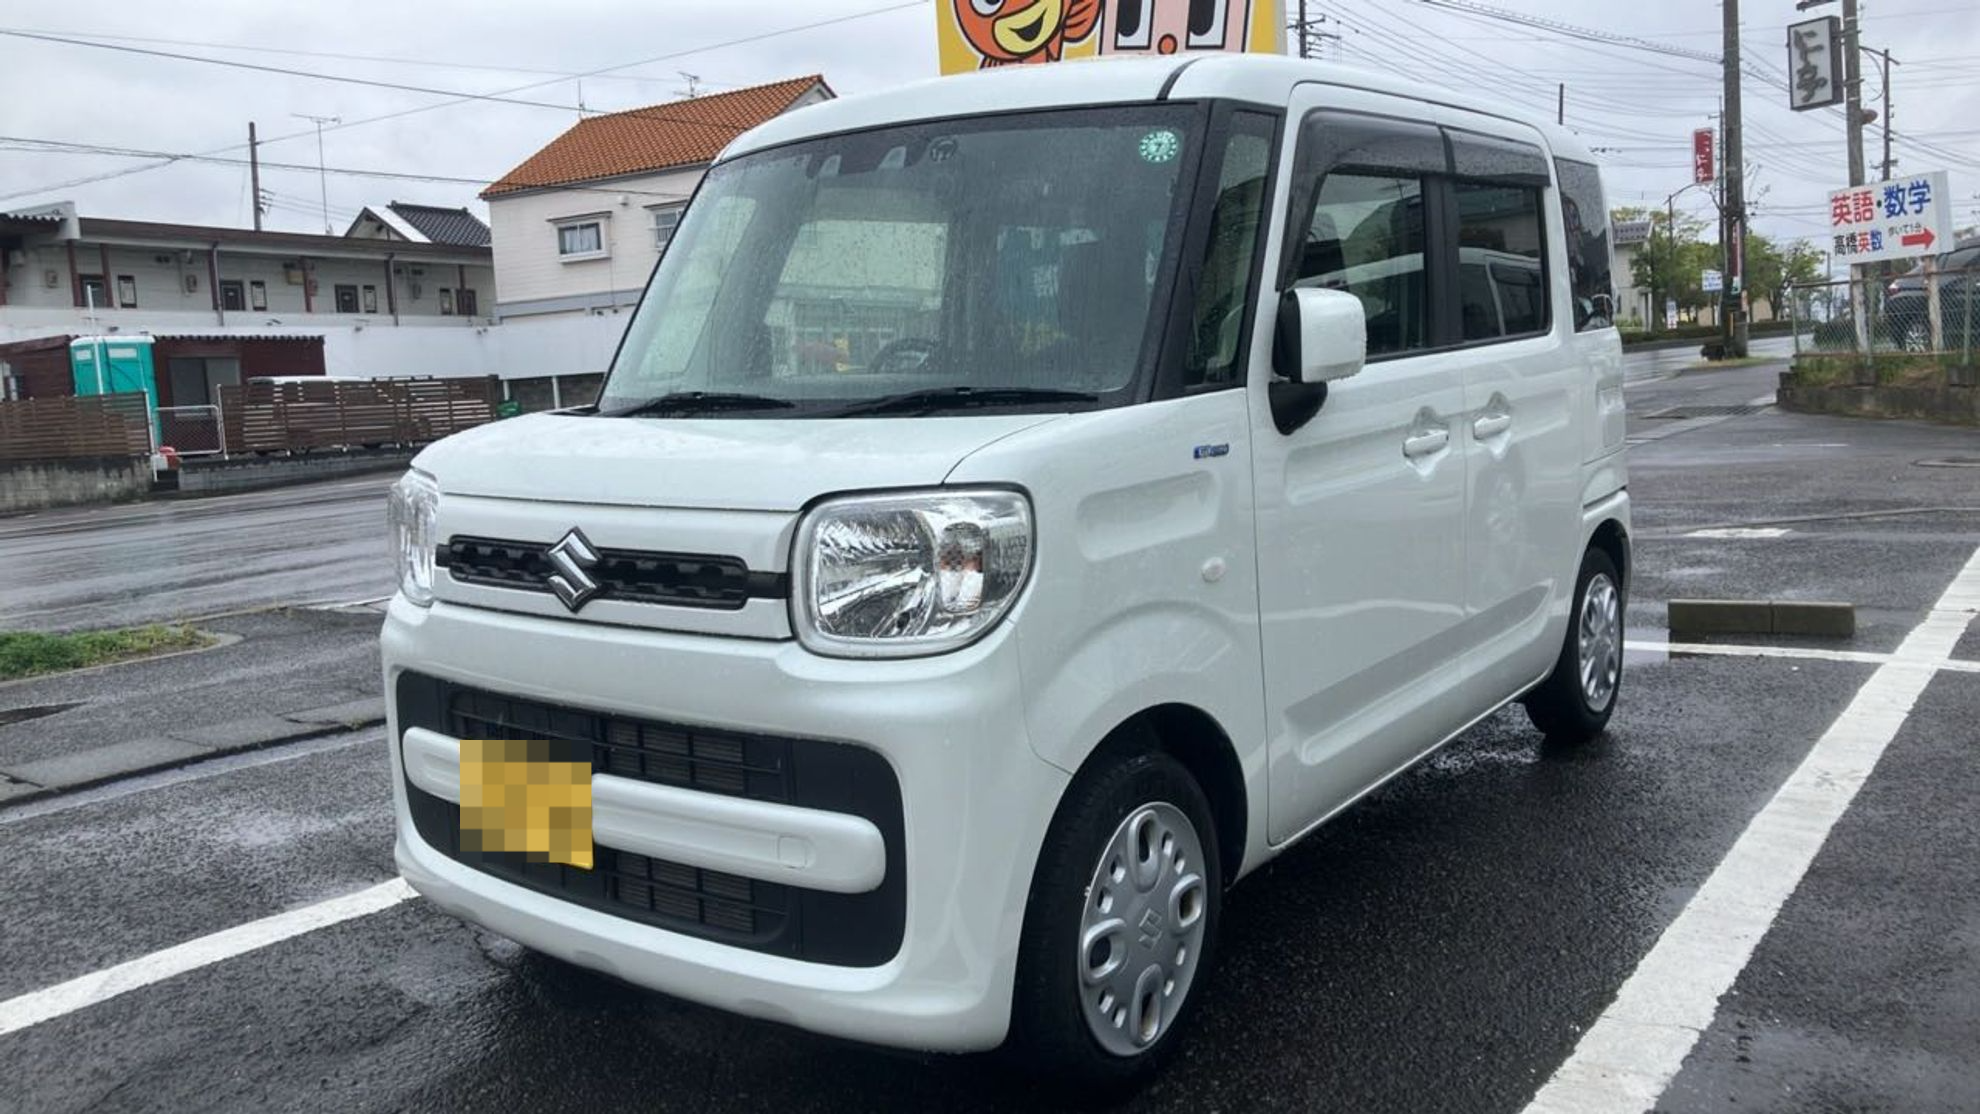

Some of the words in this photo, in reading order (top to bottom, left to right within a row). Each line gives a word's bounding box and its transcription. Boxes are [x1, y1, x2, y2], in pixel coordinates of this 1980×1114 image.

[1831, 180, 1932, 227] 英語・数学
[1833, 229, 1884, 257] 高橋英数
